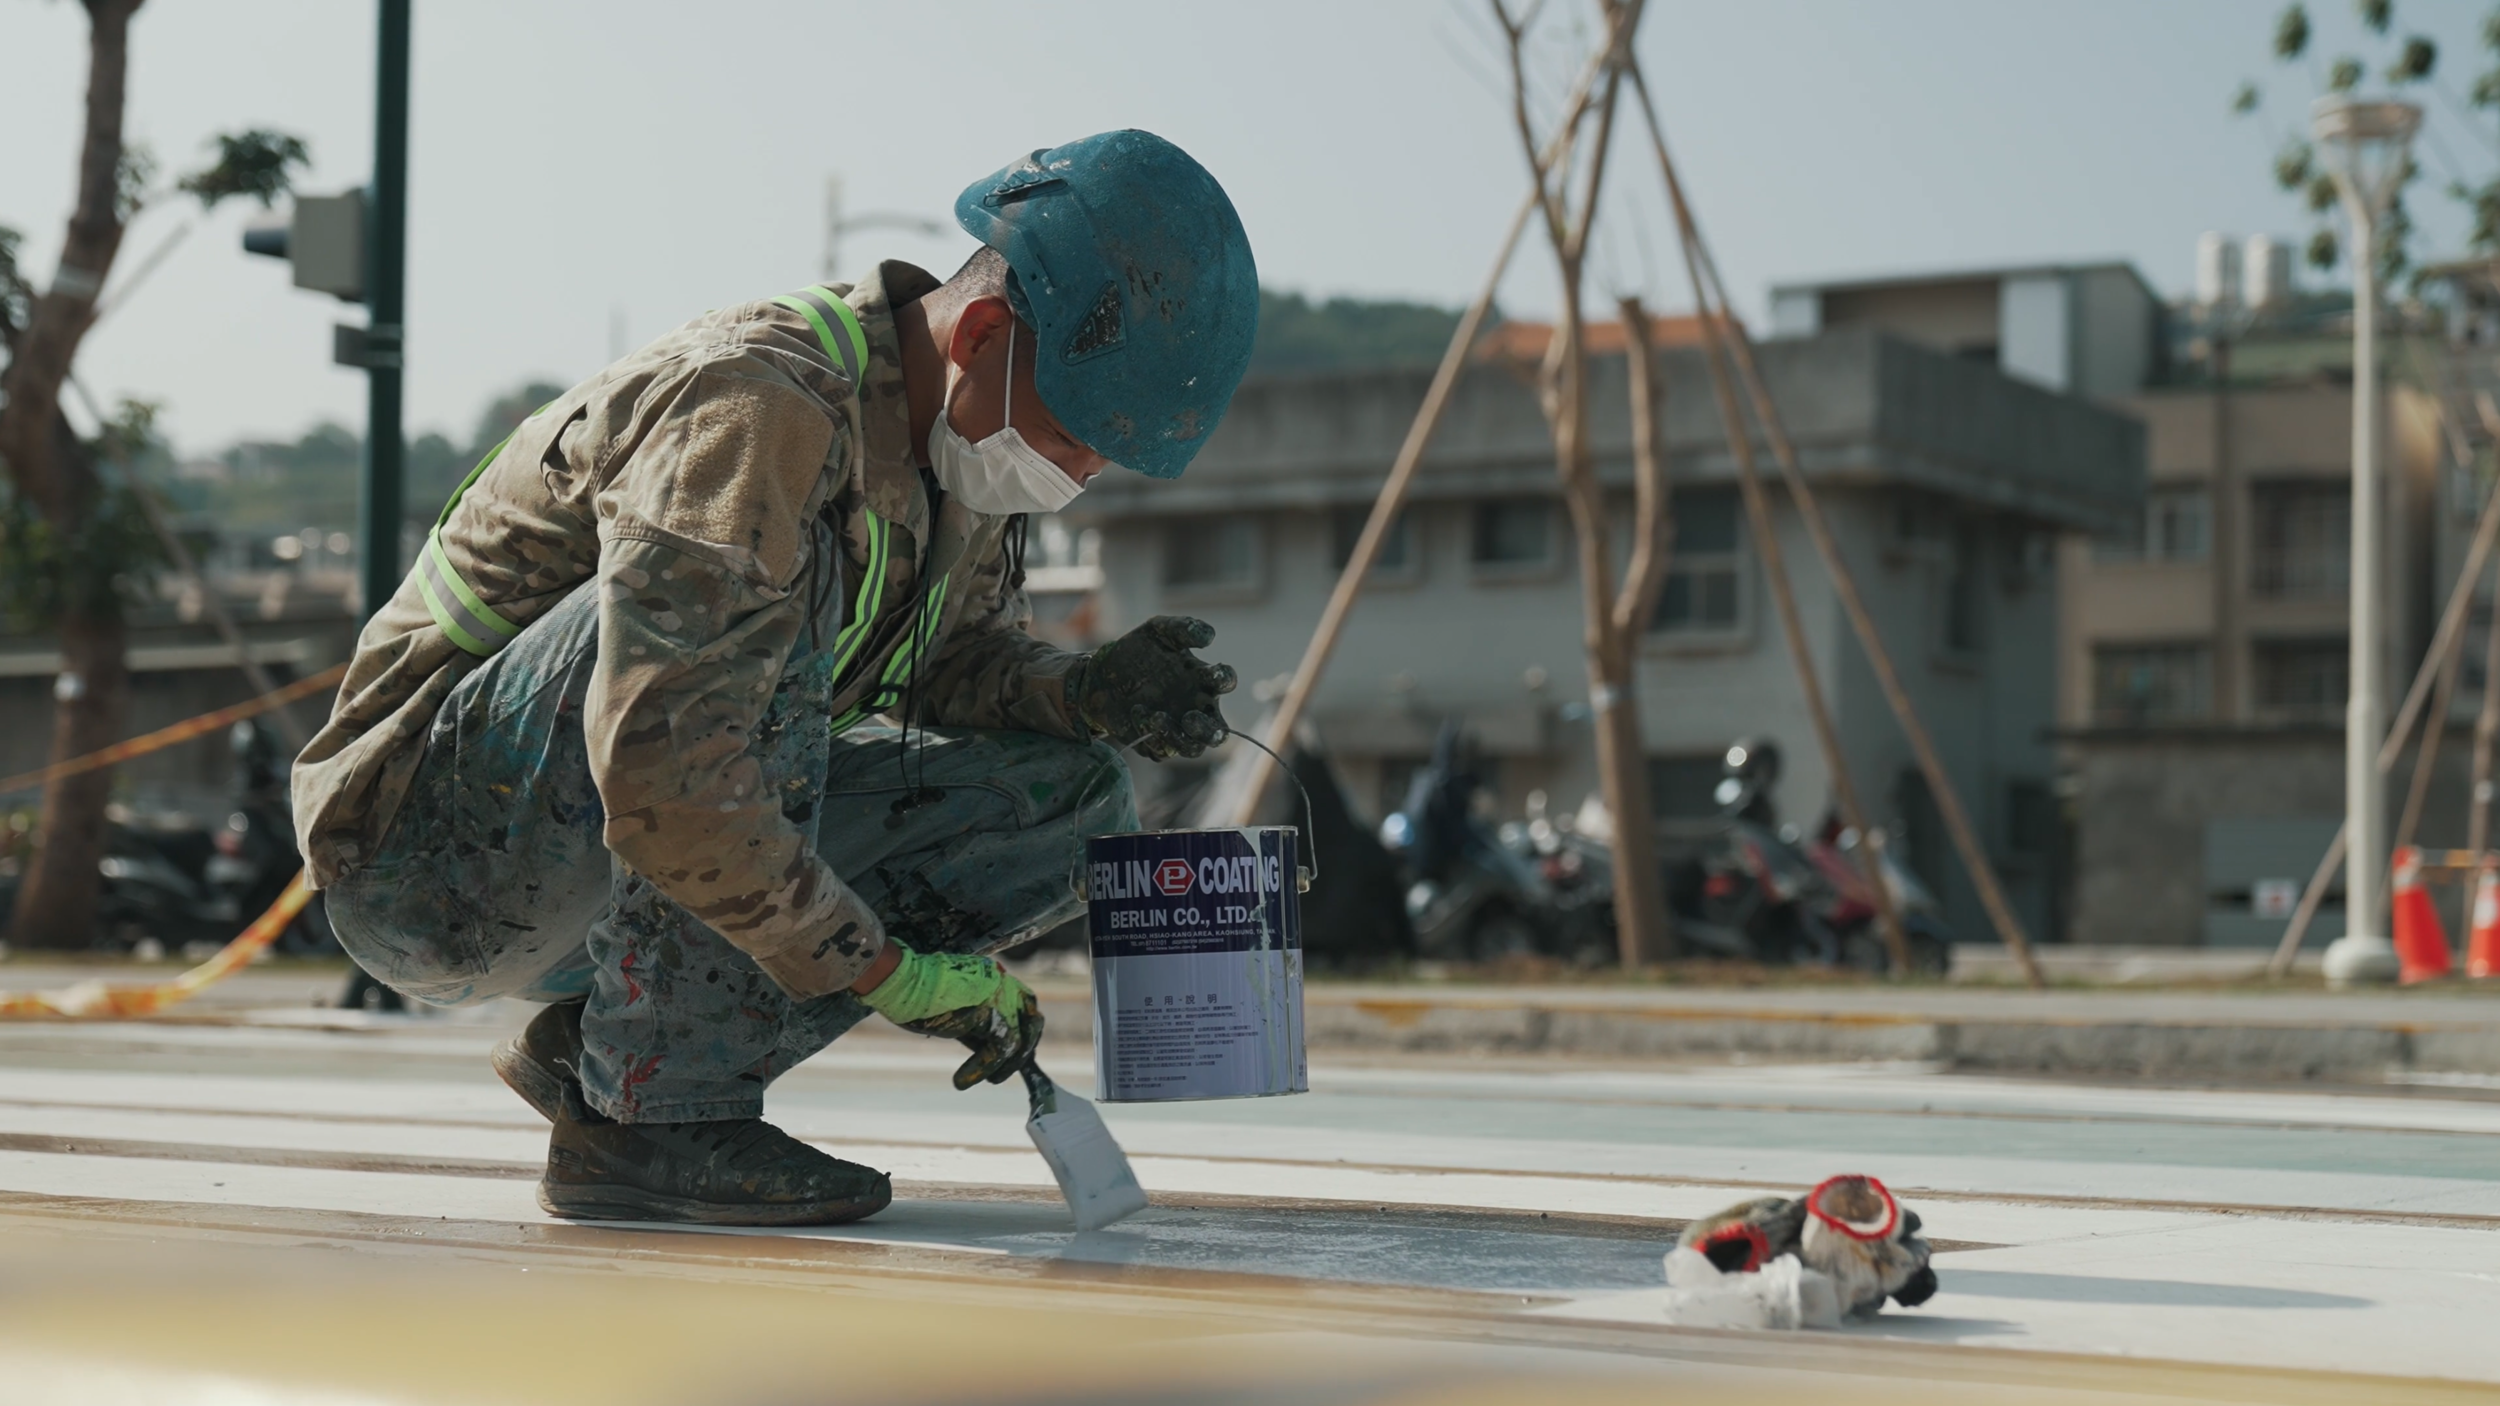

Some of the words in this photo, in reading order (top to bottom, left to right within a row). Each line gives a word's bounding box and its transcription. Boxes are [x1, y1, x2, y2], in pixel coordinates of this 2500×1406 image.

[1088, 860, 1151, 901] BERLIN
[1198, 855, 1280, 895] COATING
[1110, 909, 1167, 929] BERLIN
[1173, 908, 1210, 928] CO.,
[1216, 906, 1251, 924] LTD.
